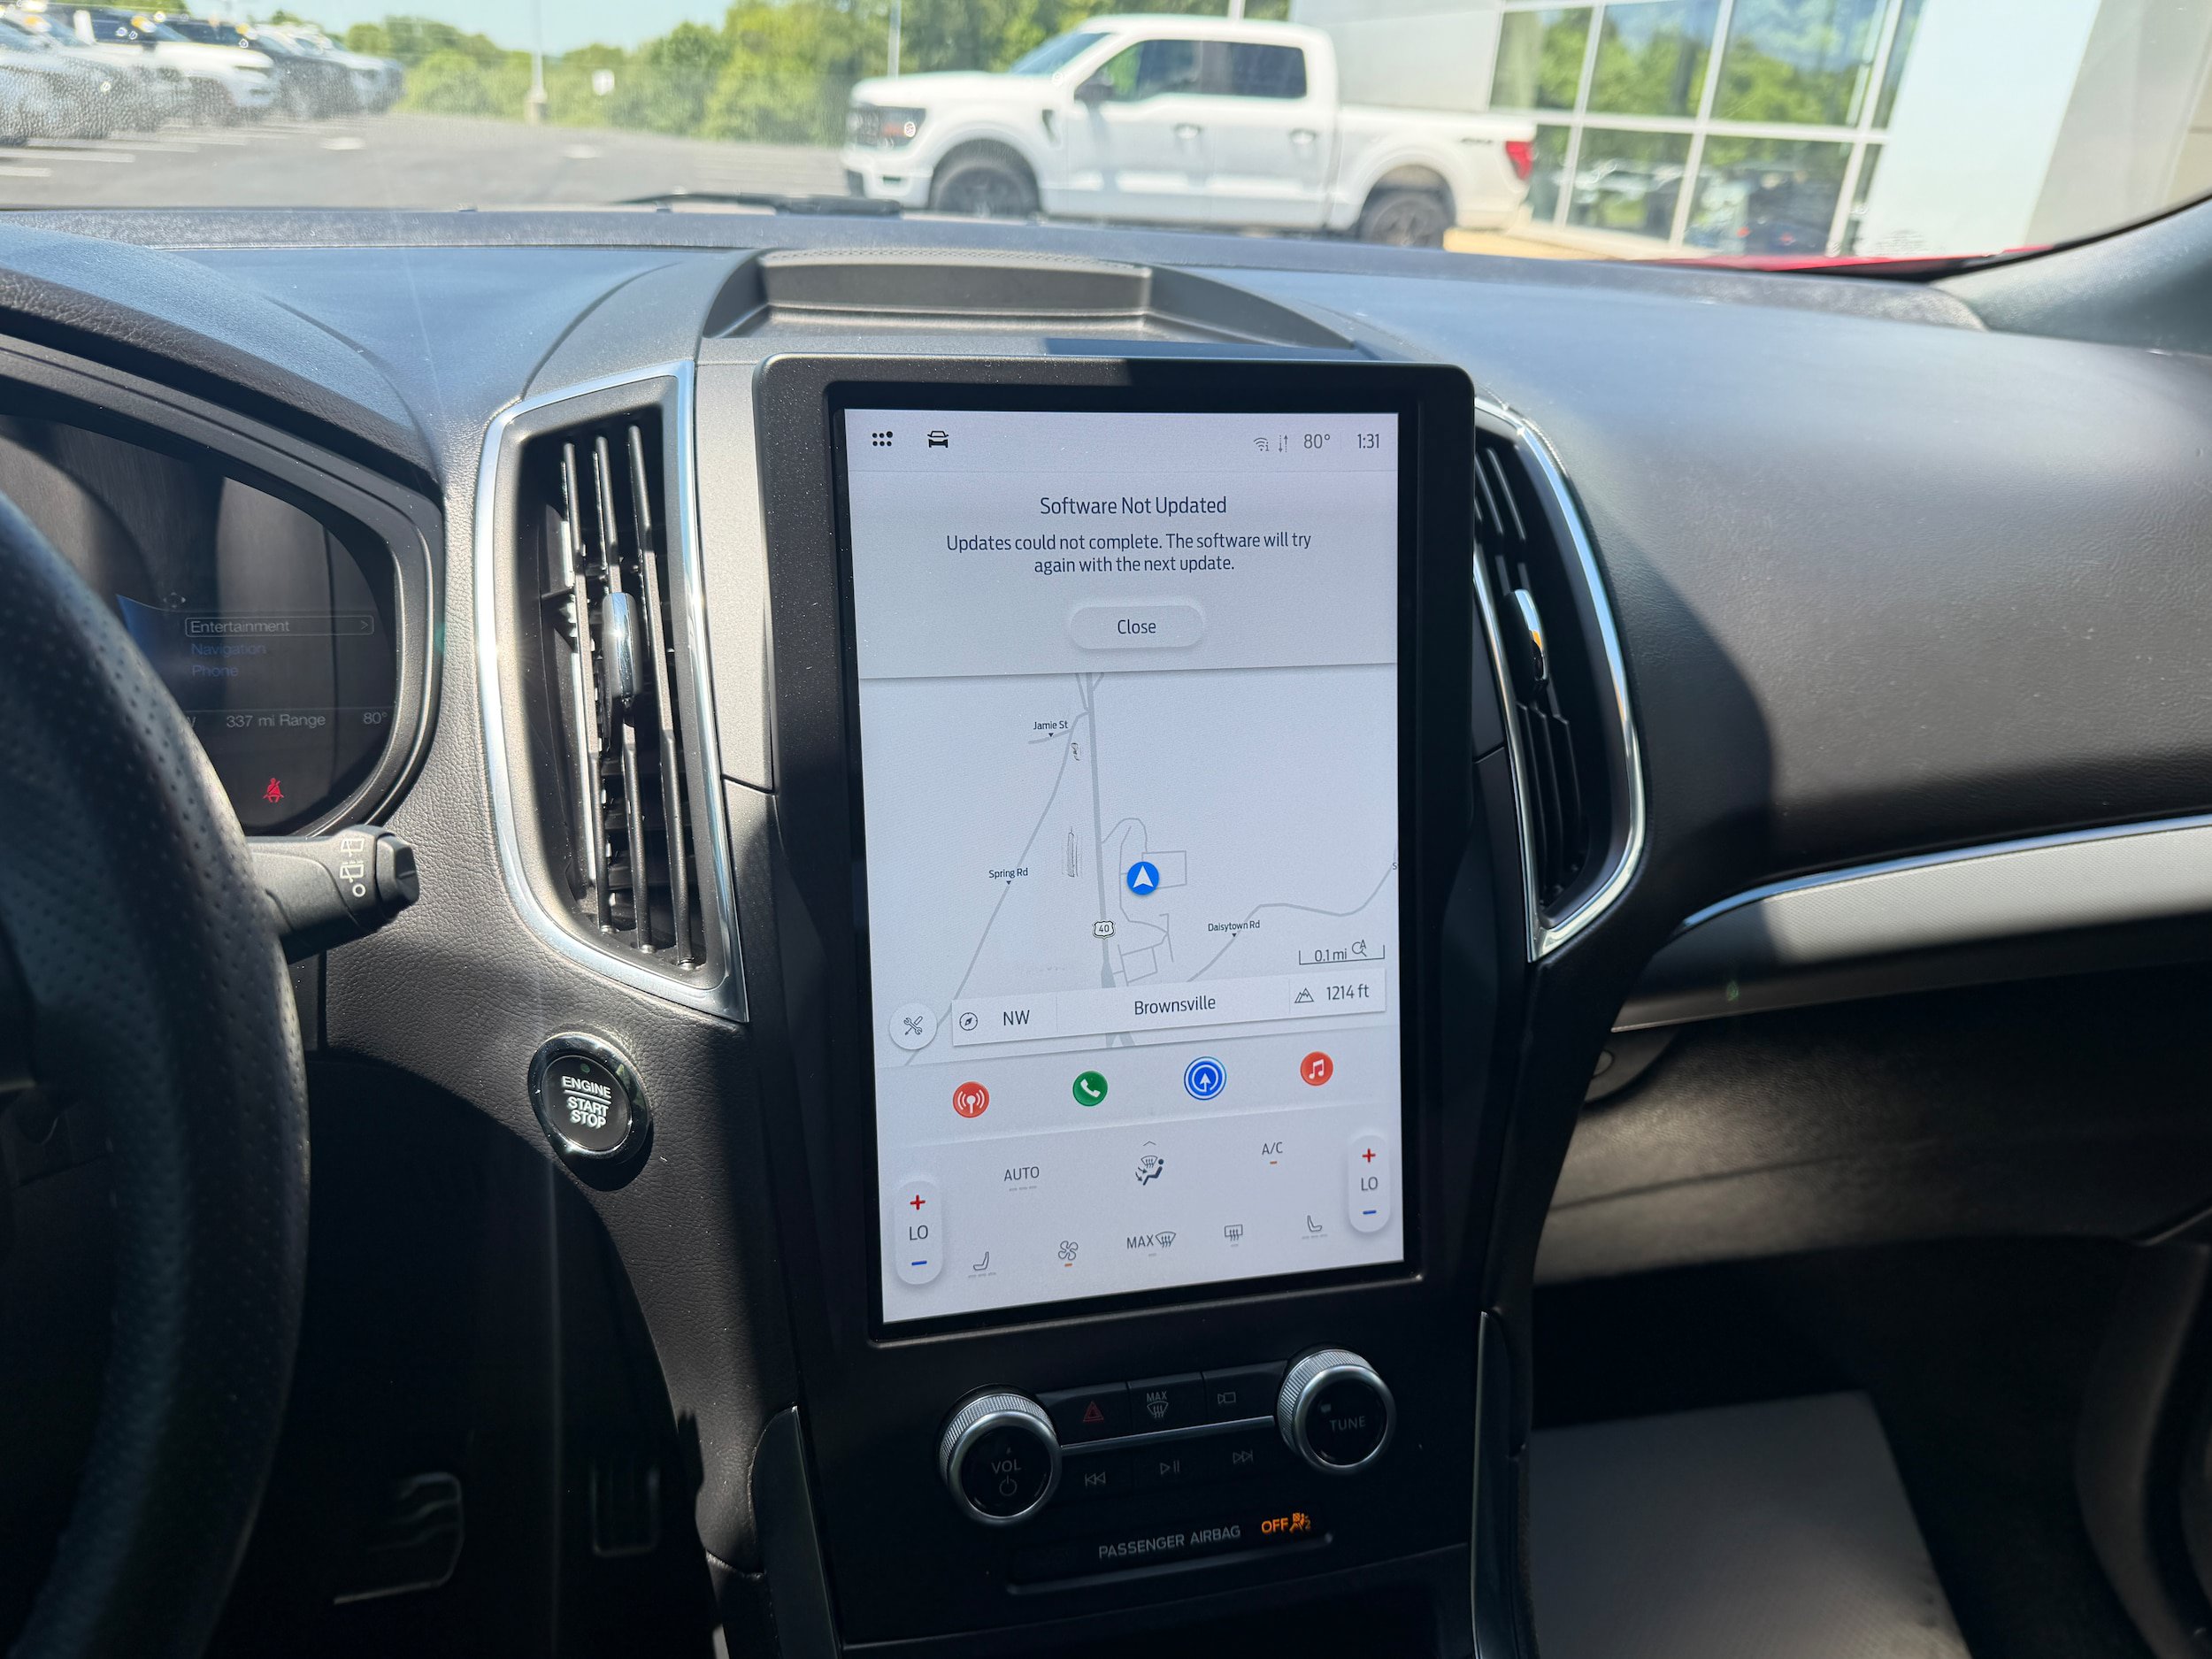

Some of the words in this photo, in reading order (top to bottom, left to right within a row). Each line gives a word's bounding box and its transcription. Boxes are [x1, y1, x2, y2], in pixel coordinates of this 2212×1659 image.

[1303, 434, 1331, 449] 80°
[1356, 434, 1380, 449] 1:31
[1040, 496, 1118, 515] Software
[1122, 496, 1151, 514] Not
[1156, 496, 1227, 517] Updated
[946, 534, 1011, 553] Updates
[1015, 534, 1056, 550] could
[1060, 536, 1086, 549] not
[1089, 534, 1163, 552] complete.
[1165, 533, 1194, 549] The
[1196, 533, 1261, 548] software
[1263, 532, 1289, 547] will
[1292, 533, 1311, 549] try
[1034, 557, 1076, 575] again
[1079, 556, 1112, 572] with
[1116, 556, 1141, 572] the
[1144, 556, 1176, 571] next
[1179, 555, 1234, 573] update.
[189, 620, 290, 634] Entertainment
[1118, 618, 1156, 634] Close
[191, 643, 265, 657] Navigation
[192, 665, 239, 678] Phone
[226, 716, 252, 728] 337
[258, 715, 275, 727] mi
[280, 715, 326, 730] Range
[363, 711, 388, 726] 80°
[1033, 721, 1056, 731] Jamie
[1058, 720, 1069, 730] St
[988, 869, 1016, 879] Spring
[1017, 867, 1028, 877] Rd
[1208, 922, 1248, 933] Daisytown
[1249, 920, 1261, 930] Rd
[1315, 950, 1330, 963] 0.1
[1333, 949, 1348, 961] mi
[1326, 986, 1355, 1001] 1214
[1357, 984, 1370, 998] ft
[1134, 995, 1216, 1015] Brownsville
[1003, 1010, 1030, 1025] NW
[562, 1075, 611, 1099] ENGINE
[567, 1095, 609, 1118] START
[570, 1110, 606, 1129] STOP
[1262, 1141, 1284, 1156] A/C
[1003, 1166, 1040, 1182] AUTO
[1361, 1177, 1379, 1191] LO
[909, 1225, 928, 1240] LO
[1126, 1233, 1154, 1249] MAX
[1146, 1391, 1168, 1402] MAX
[1329, 1416, 1366, 1432] TUNE
[991, 1459, 1021, 1474] VOL
[1099, 1533, 1185, 1559] PASSENGER
[1190, 1525, 1241, 1545] AIRBAG
[1261, 1517, 1288, 1533] OFF
